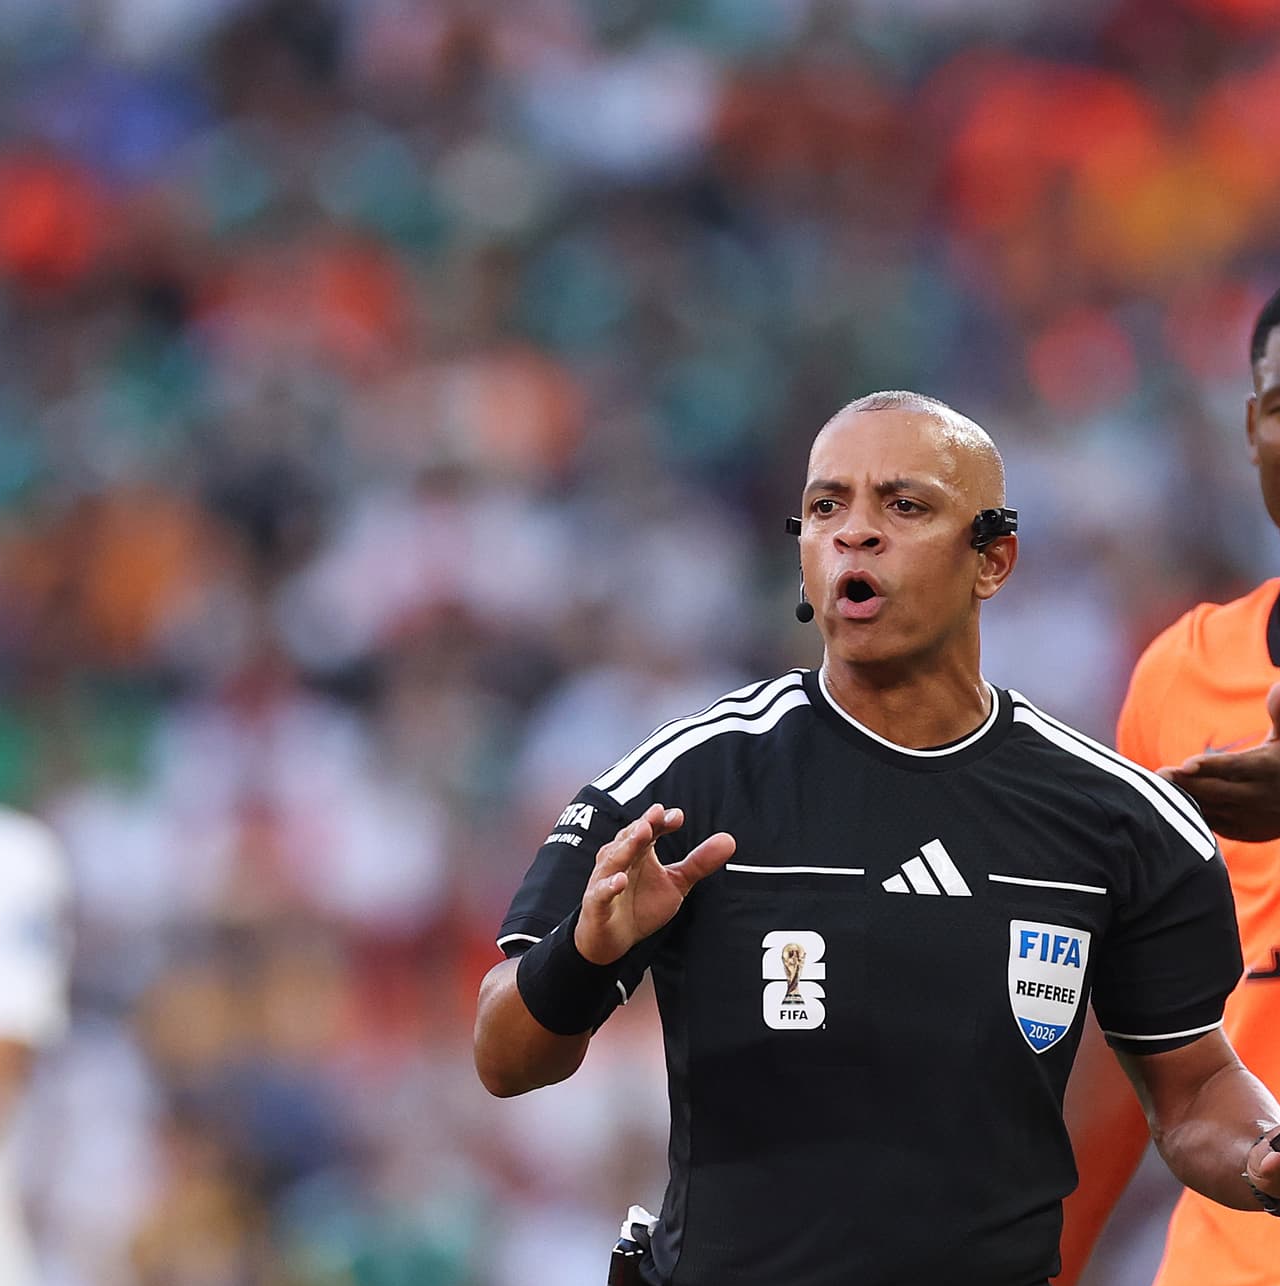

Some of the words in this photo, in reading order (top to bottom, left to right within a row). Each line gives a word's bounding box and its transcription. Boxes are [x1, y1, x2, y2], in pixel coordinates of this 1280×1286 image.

[1019, 930, 1081, 968] FIFA
[1016, 979, 1076, 1005] REFEREE
[780, 1009, 809, 1021] FIFA
[1028, 1023, 1057, 1042] 2026
